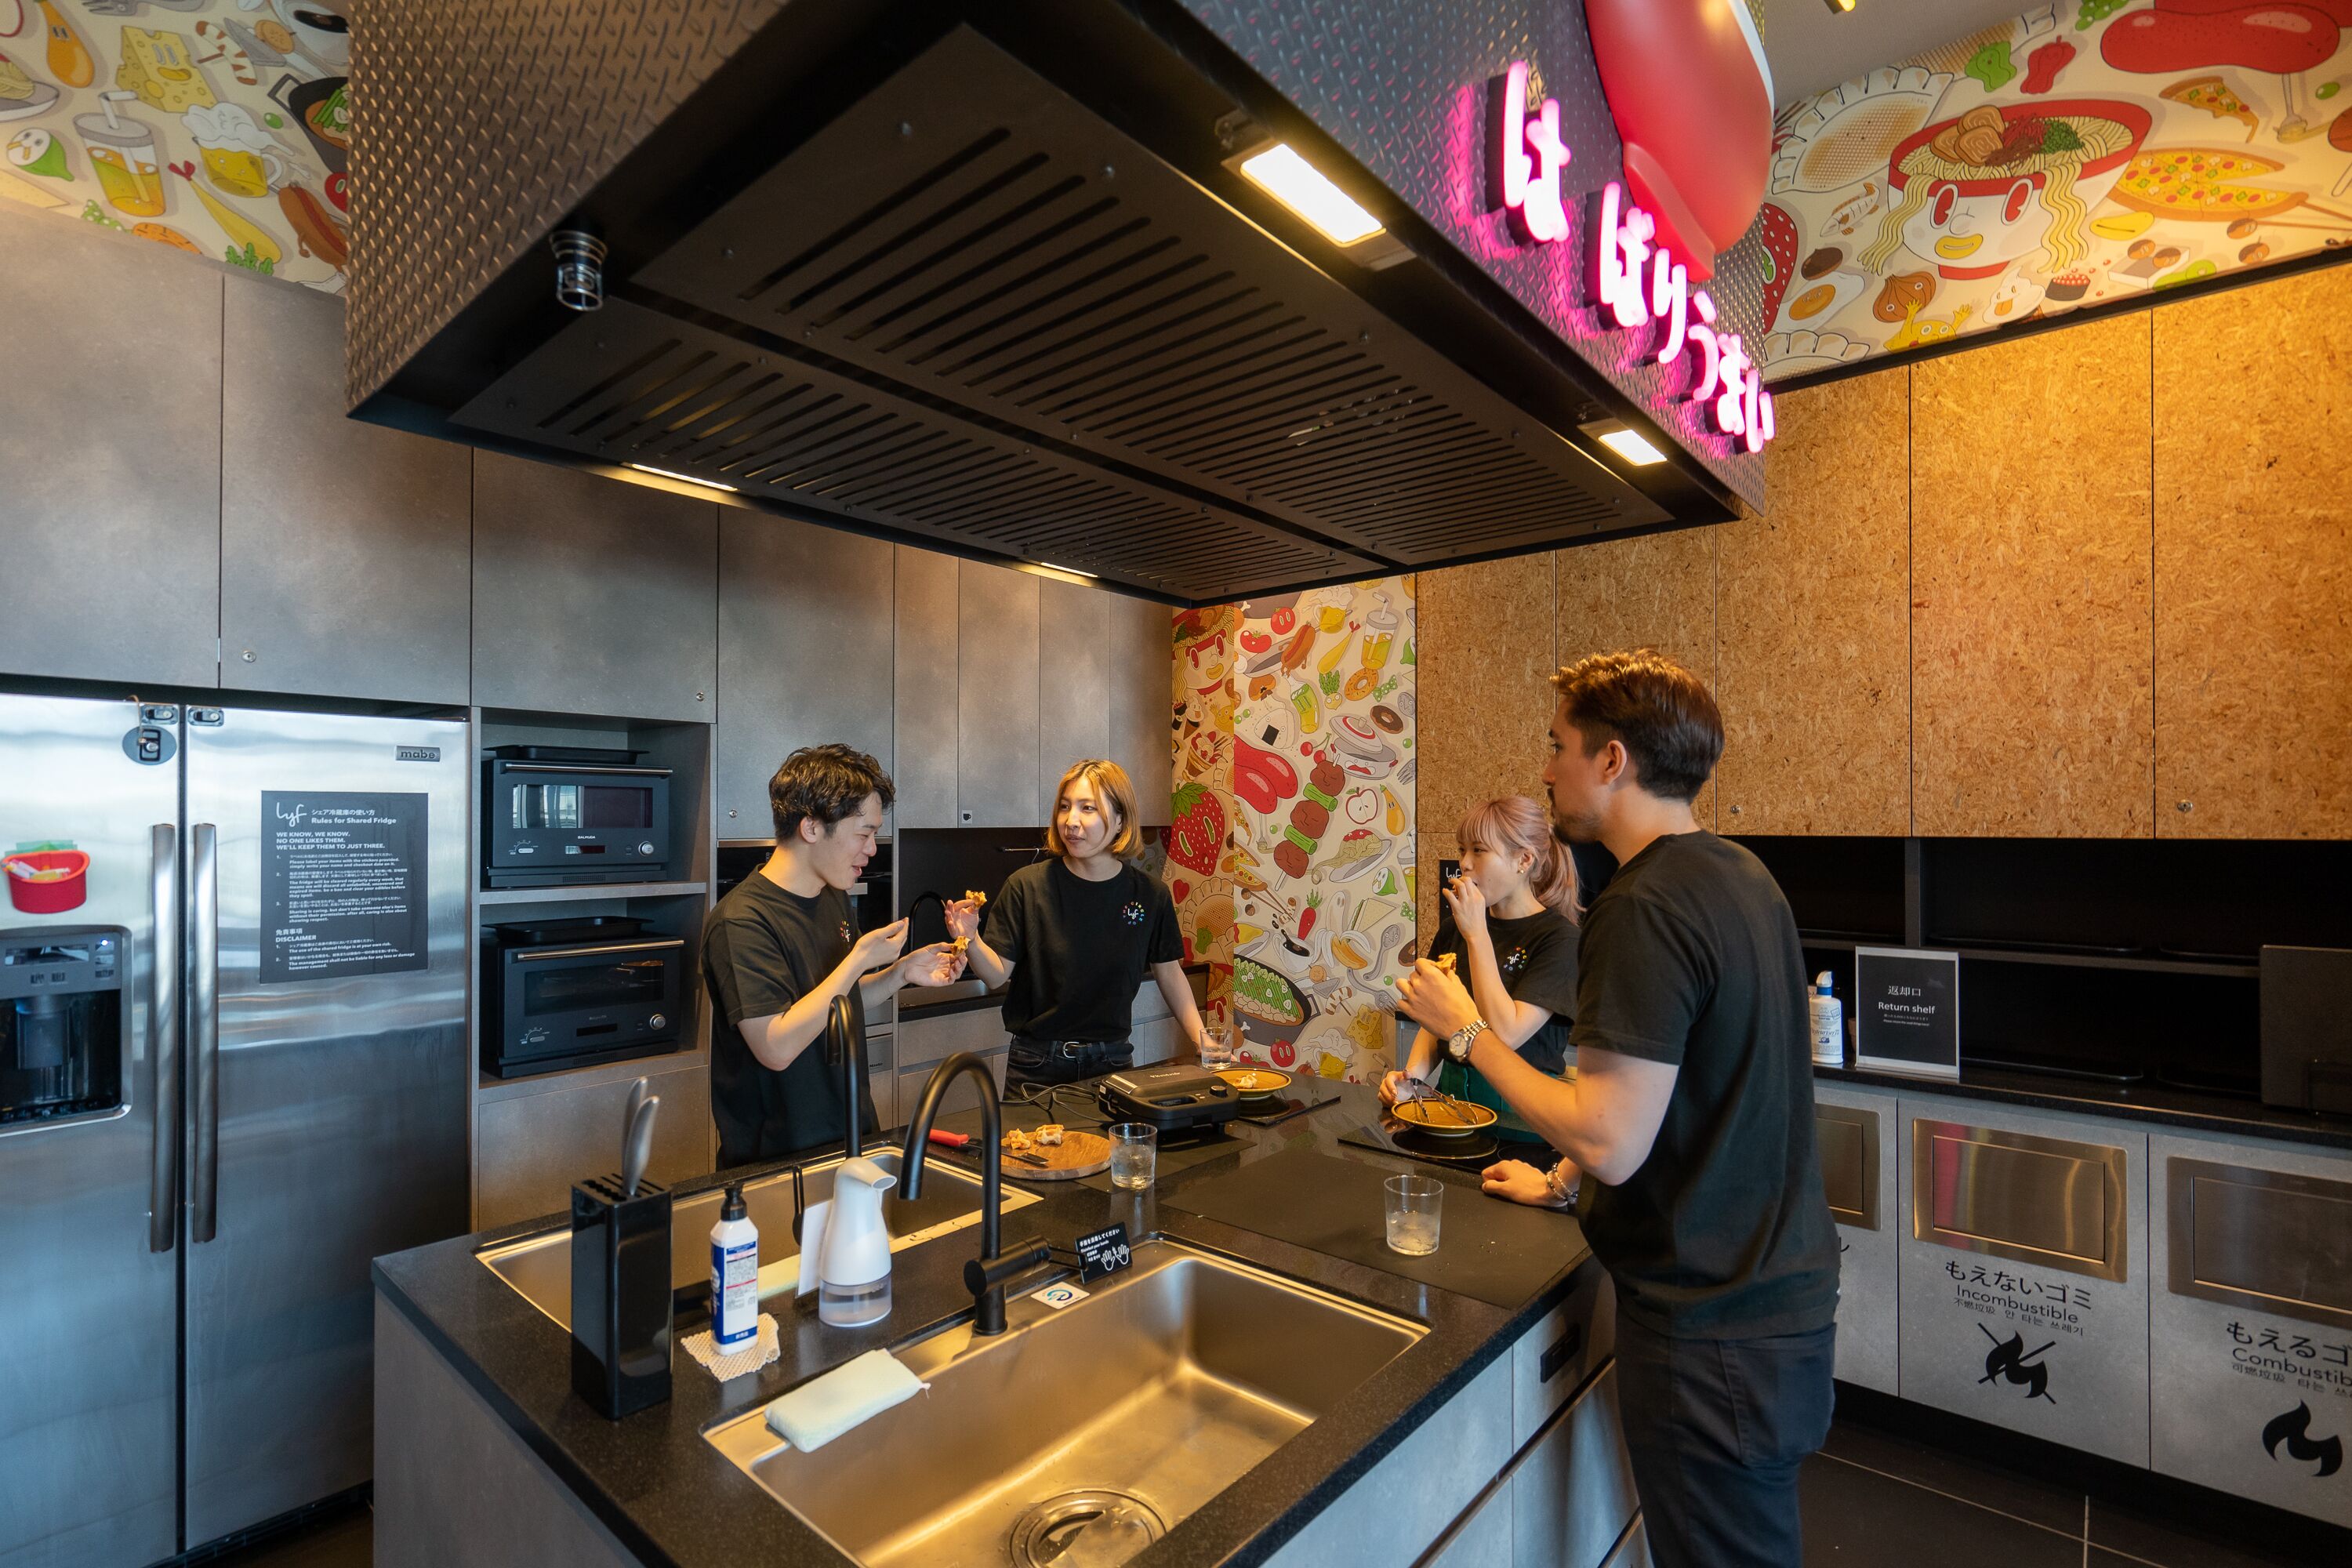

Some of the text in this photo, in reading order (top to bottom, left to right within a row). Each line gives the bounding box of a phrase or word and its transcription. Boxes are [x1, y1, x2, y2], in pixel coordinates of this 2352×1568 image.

[401, 749, 435, 759] mabe
[277, 802, 307, 826] lyf
[1127, 908, 1139, 920] lyf
[1888, 985, 1921, 996] 返却口
[1878, 1001, 1936, 1014] Return shelf
[1945, 1261, 2091, 1310] もえないゴミ
[1957, 1285, 2078, 1323] Incombustible
